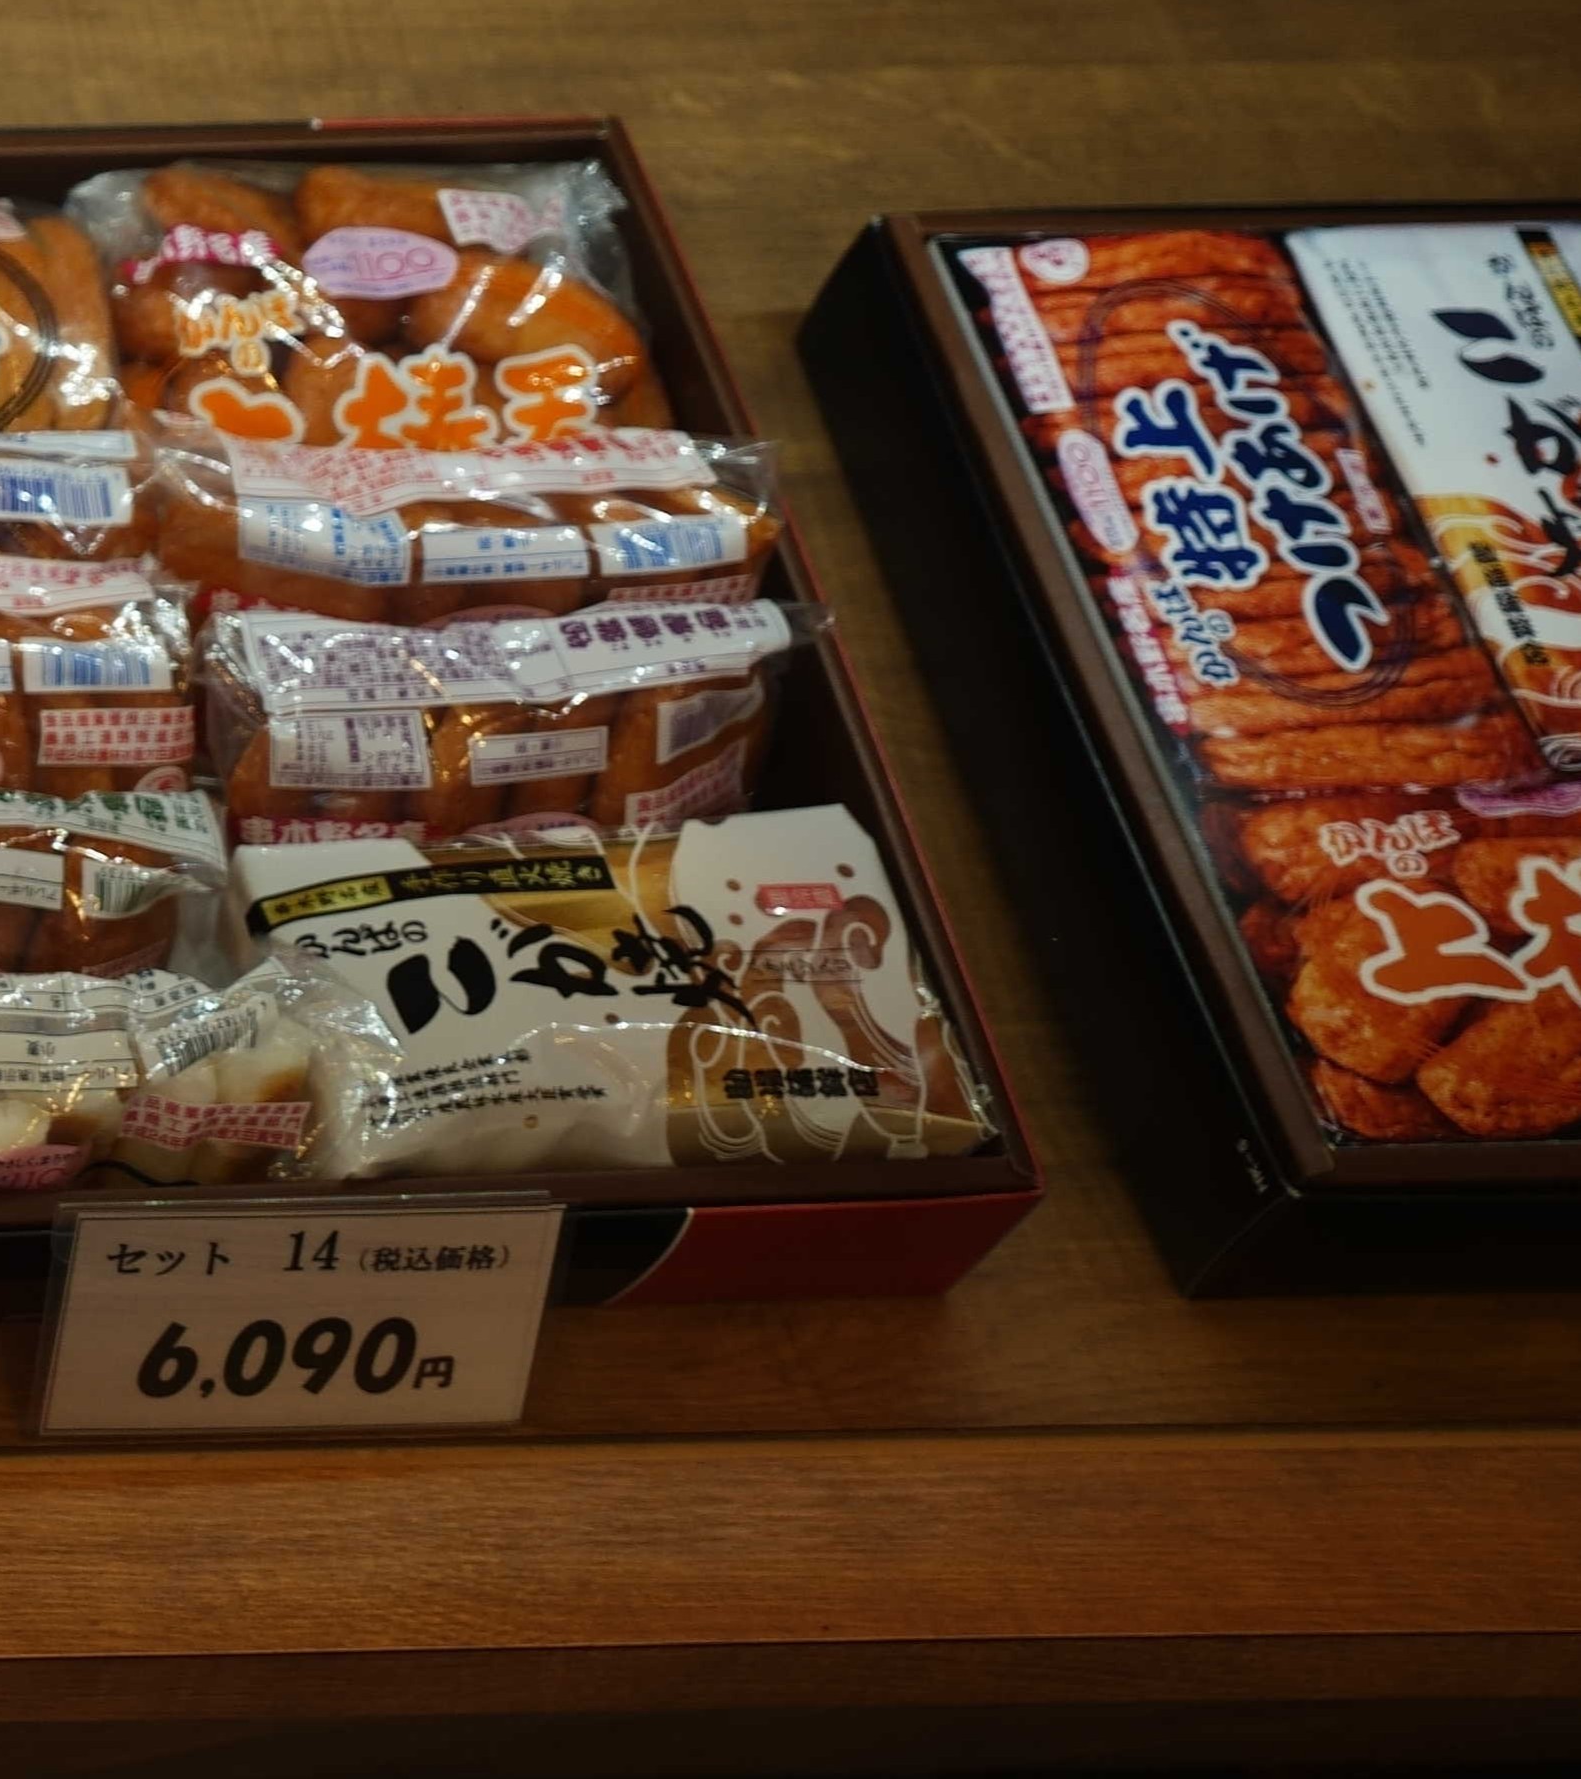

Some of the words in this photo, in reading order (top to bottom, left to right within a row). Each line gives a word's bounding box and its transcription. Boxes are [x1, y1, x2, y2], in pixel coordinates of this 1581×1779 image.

[1115, 385, 1262, 585] 特上
[1180, 324, 1389, 667] つけあげ
[107, 1241, 231, 1276] セット
[282, 1228, 342, 1272] 14
[357, 1244, 512, 1273] (税込価格)
[136, 1315, 456, 1398] 6,090円
